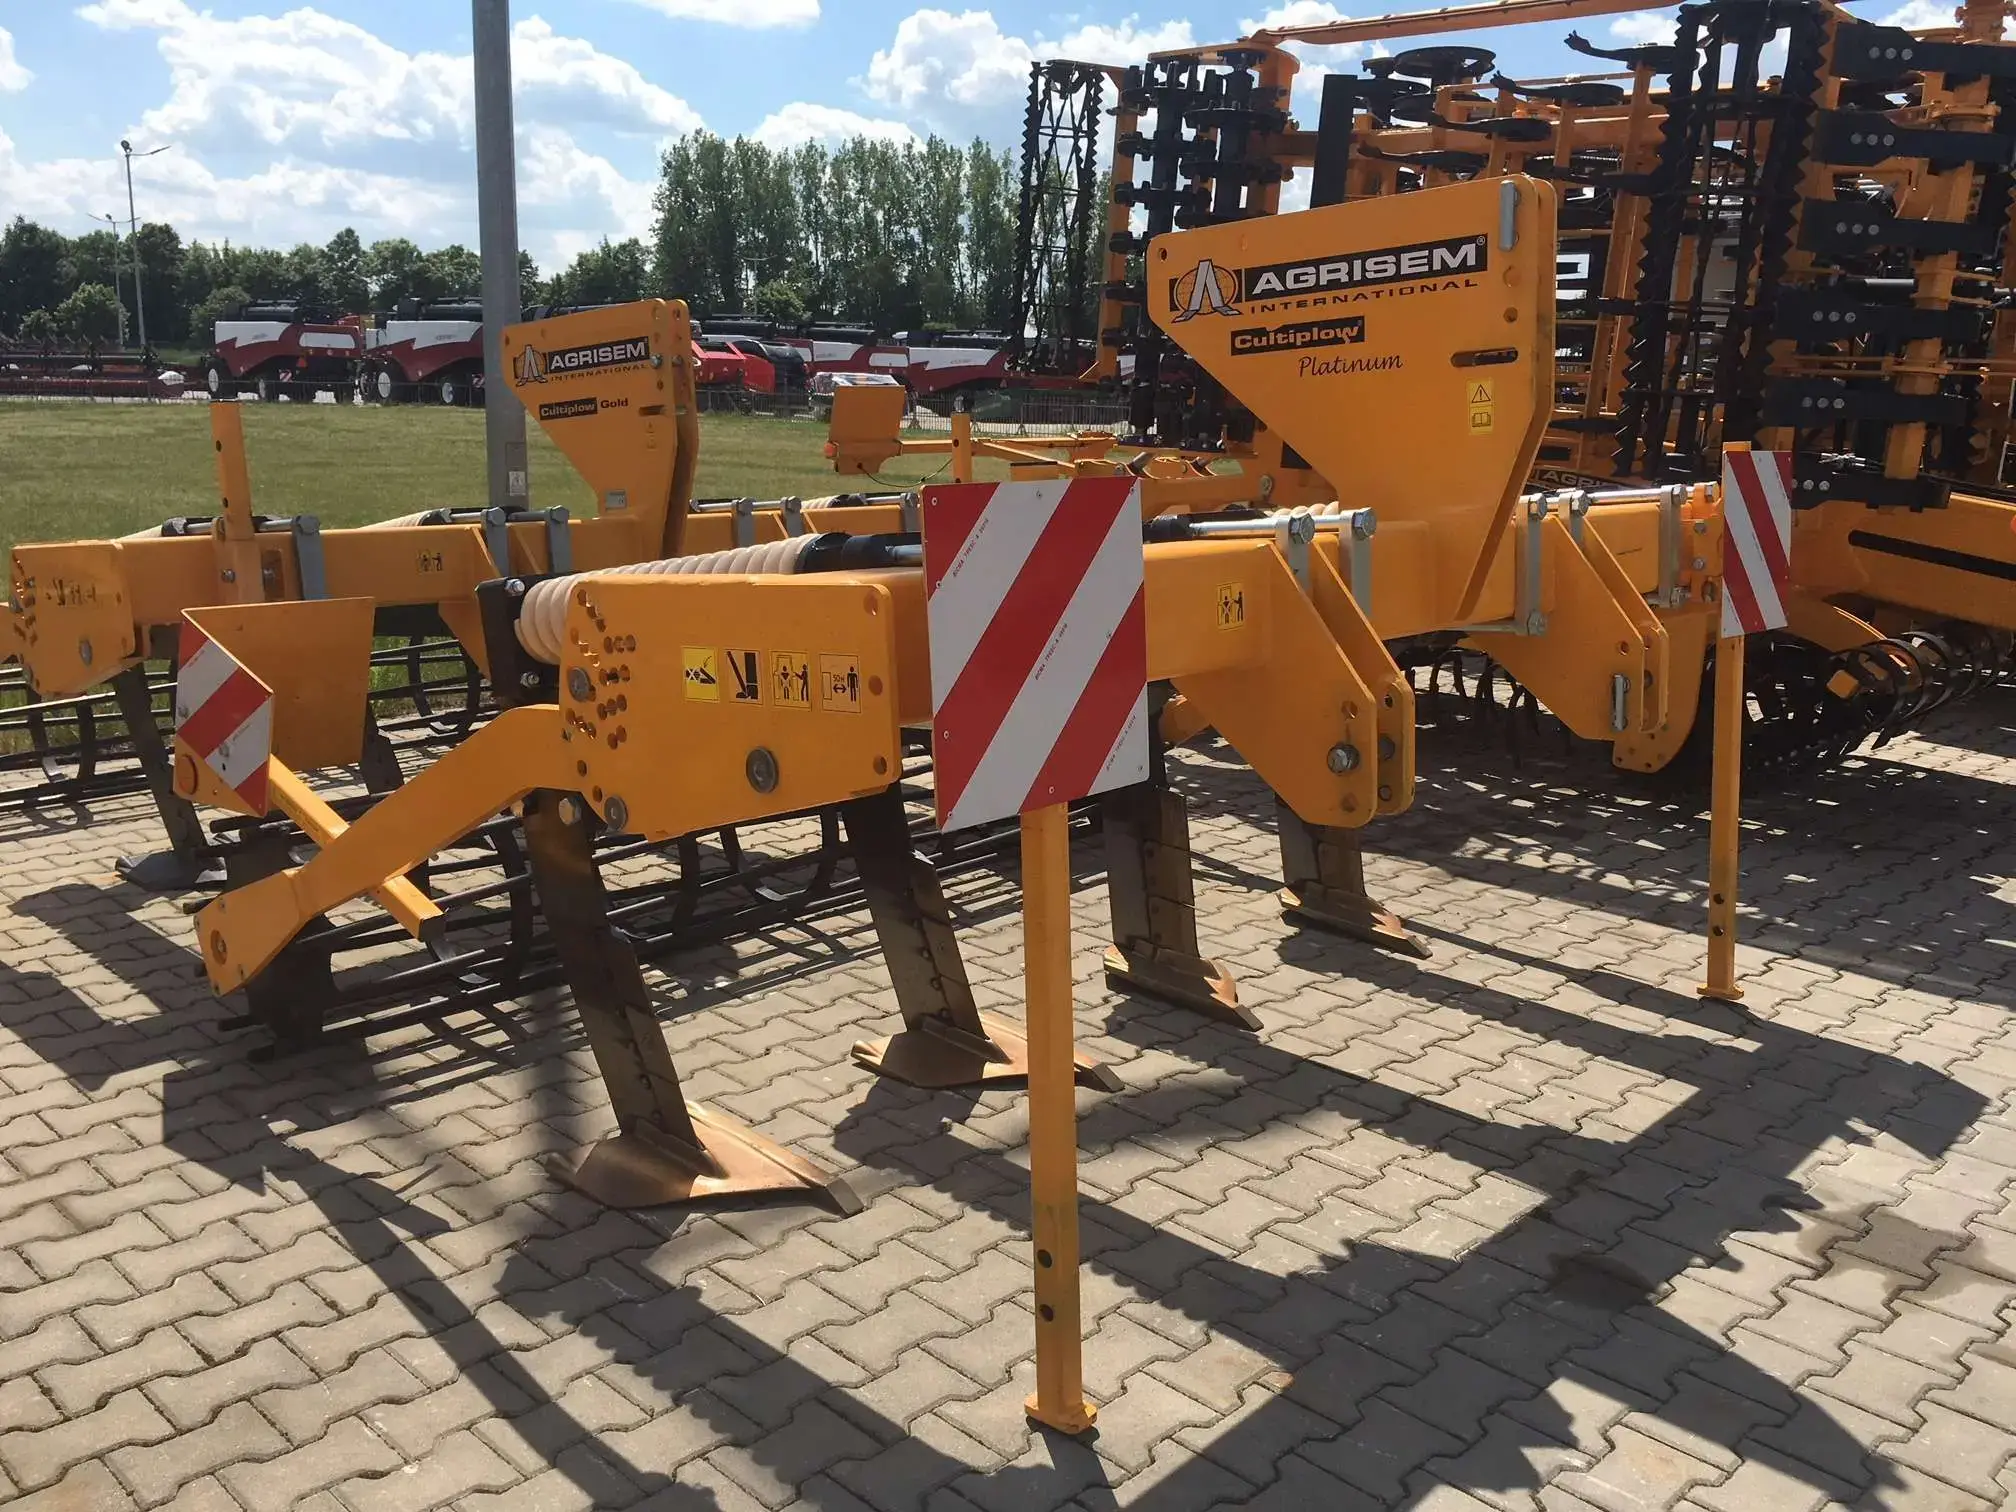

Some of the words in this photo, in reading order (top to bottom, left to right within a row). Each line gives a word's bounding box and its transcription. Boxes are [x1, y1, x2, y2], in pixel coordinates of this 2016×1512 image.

[1251, 243, 1477, 295] AGRISEM
[1250, 278, 1479, 315] INTERNATIONAL
[1234, 324, 1360, 349] Cultiplow
[550, 342, 645, 371] AGRISEM
[1299, 353, 1404, 377] Platinum
[551, 363, 648, 381] INTERNATIONAL
[541, 402, 596, 417] Cultiplow
[600, 398, 629, 409] Gold
